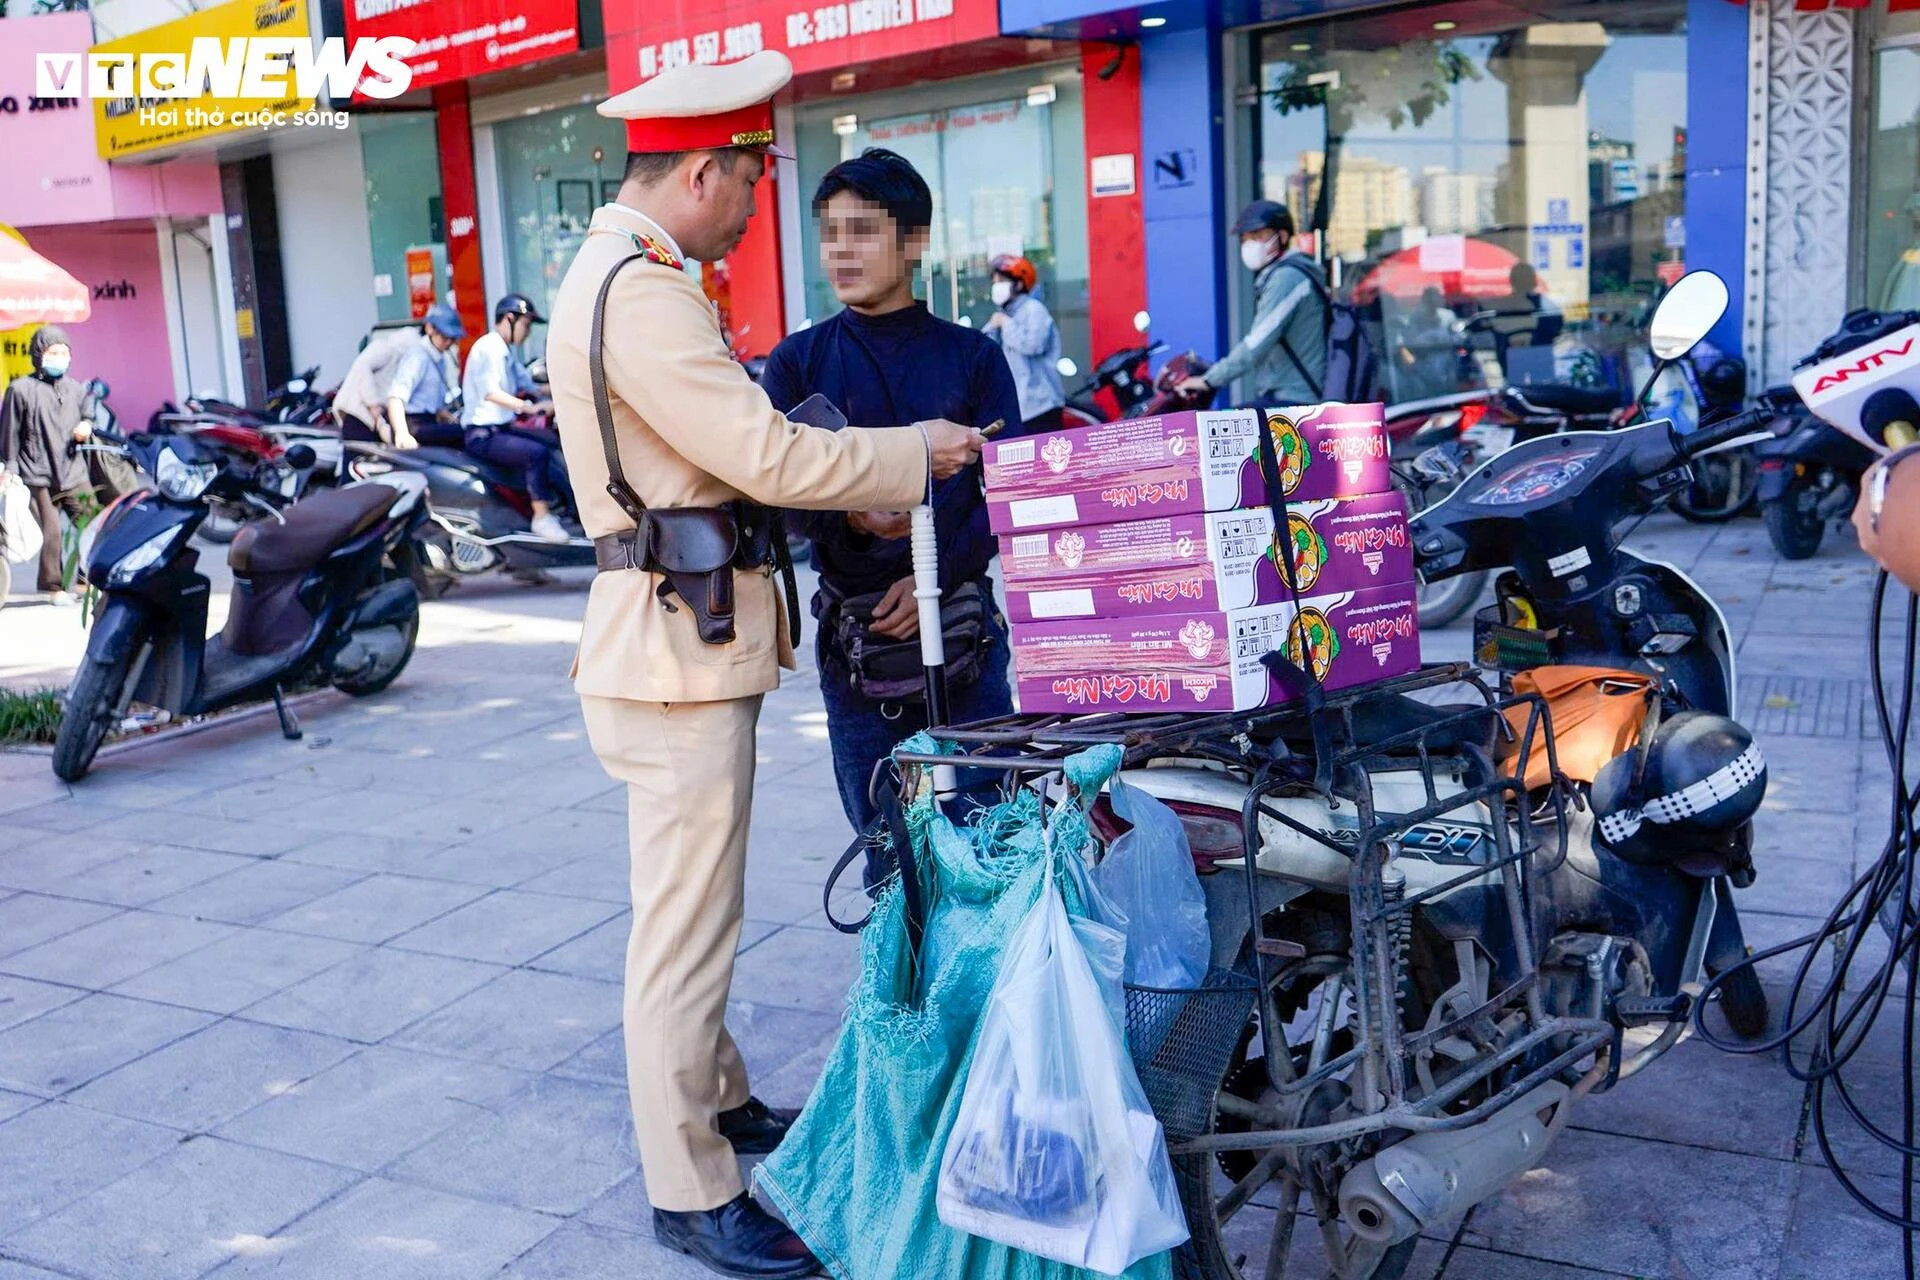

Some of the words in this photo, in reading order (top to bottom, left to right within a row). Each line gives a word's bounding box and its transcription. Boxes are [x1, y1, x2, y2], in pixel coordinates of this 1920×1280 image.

[93, 278, 136, 300] xinh
[1812, 337, 1915, 395] ANTV
[1101, 487, 1137, 508] Nấm
[1138, 484, 1163, 504] Gà
[1166, 480, 1187, 501] Mì
[1334, 531, 1364, 555] Nấm
[1365, 528, 1386, 550] Gà
[1386, 524, 1404, 548] Mì
[1118, 583, 1153, 604] Nấm
[1153, 581, 1179, 601] Gà
[1180, 578, 1203, 599] Mì
[1347, 621, 1376, 645] Nấm
[1376, 617, 1395, 641] Gà
[1395, 614, 1412, 638] Mì
[1052, 678, 1100, 705] Nấm
[1102, 675, 1136, 703] Gà
[1138, 673, 1170, 703] Mì
